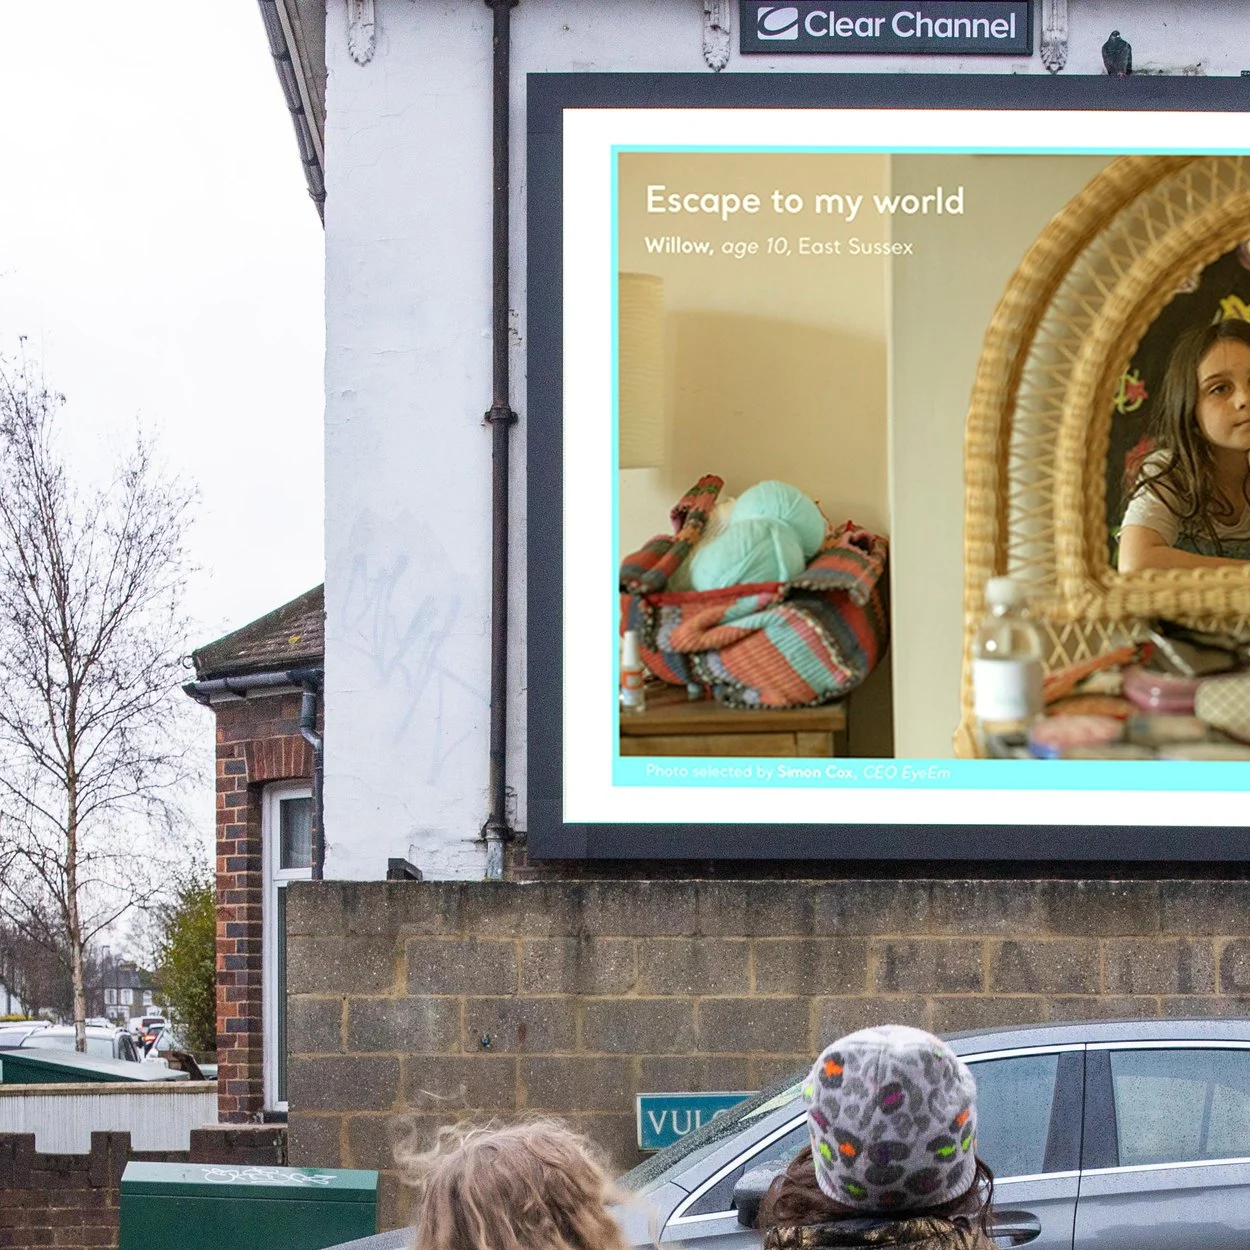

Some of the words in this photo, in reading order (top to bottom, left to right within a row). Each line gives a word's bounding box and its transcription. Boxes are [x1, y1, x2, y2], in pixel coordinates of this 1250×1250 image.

[804, 10, 886, 37] Clear
[891, 11, 1016, 39] Channel
[647, 185, 761, 222] Escape
[815, 194, 863, 222] my
[873, 186, 964, 214] world
[771, 190, 803, 214] to
[644, 236, 714, 256] Willow,
[721, 241, 759, 259] age
[767, 236, 792, 257] 10,
[799, 237, 841, 255] East
[848, 237, 913, 255] Sussex
[645, 763, 689, 778] Photo
[691, 764, 753, 778] selected
[755, 763, 774, 782] by
[777, 764, 822, 779] Simon
[825, 765, 858, 780] Cox,
[863, 765, 898, 780] CEO
[901, 765, 951, 783] EyeEm
